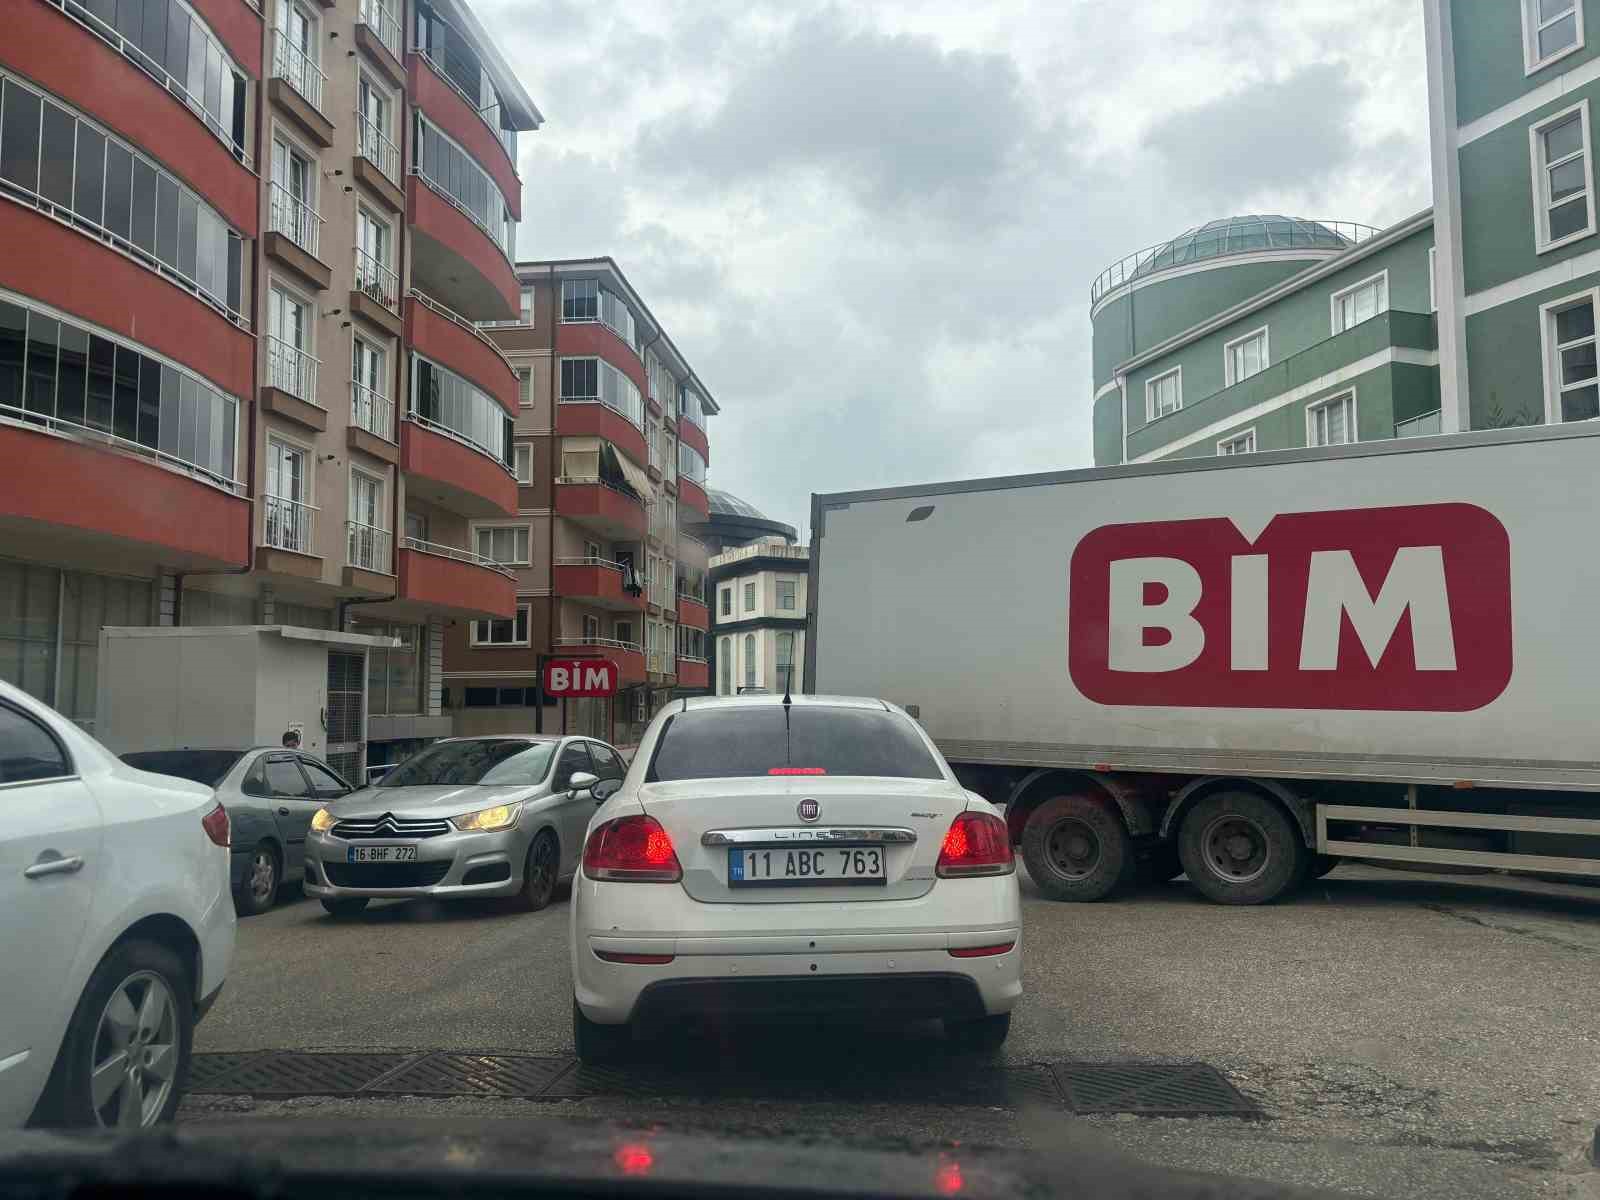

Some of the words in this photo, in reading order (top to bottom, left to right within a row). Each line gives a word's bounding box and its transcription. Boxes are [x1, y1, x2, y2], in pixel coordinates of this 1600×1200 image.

[550, 661, 610, 691] BİM
[802, 804, 817, 816] FIAT
[355, 848, 366, 860] 16
[371, 847, 389, 860] BHF
[395, 847, 415, 860] 272
[748, 852, 771, 877] 11
[785, 851, 825, 876] ABC
[839, 850, 880, 875] 763
